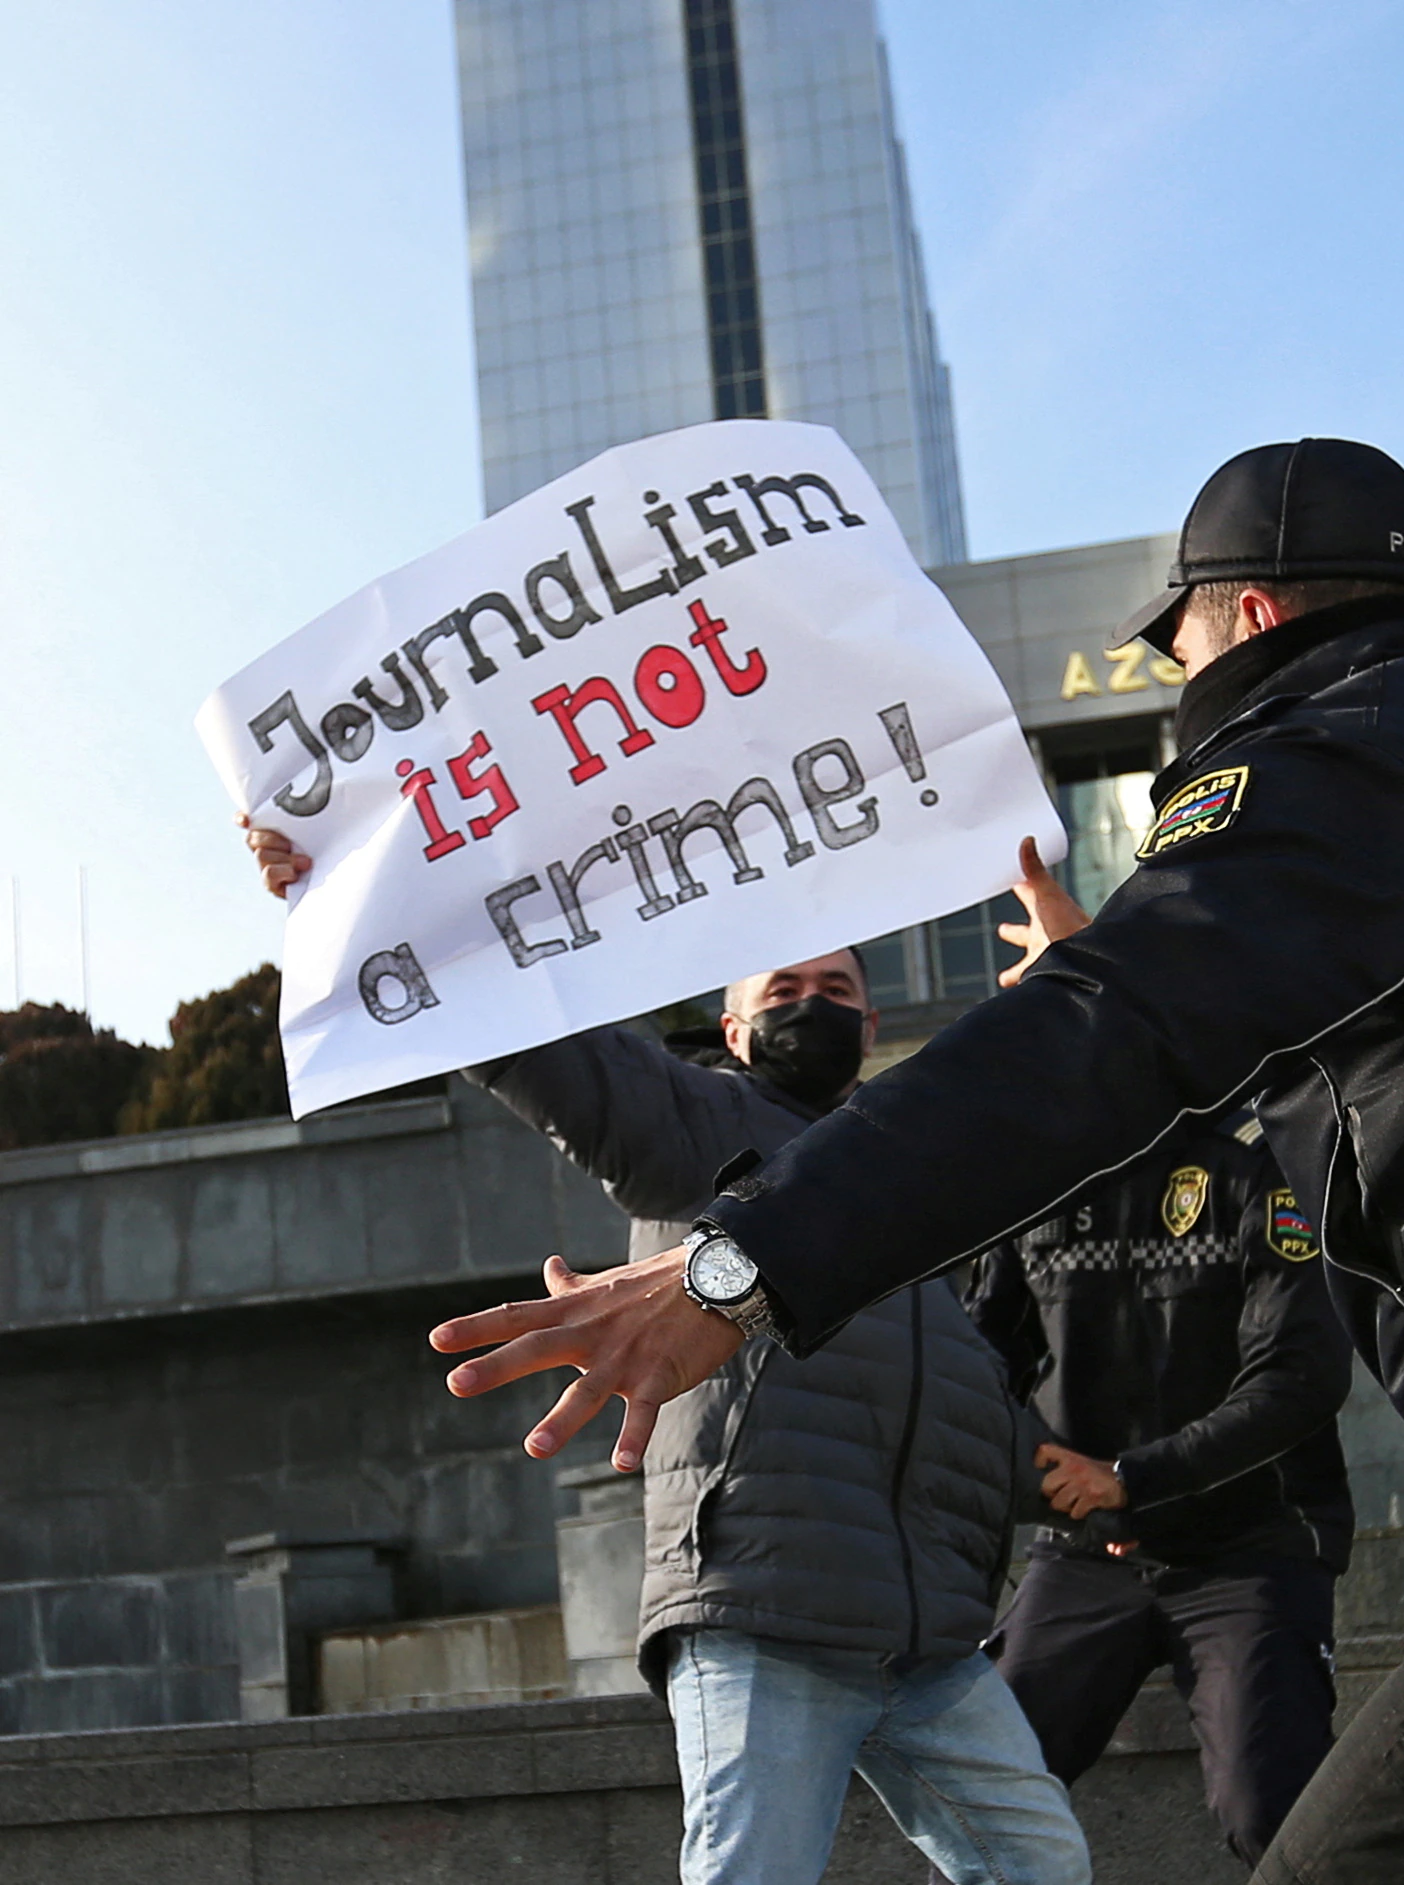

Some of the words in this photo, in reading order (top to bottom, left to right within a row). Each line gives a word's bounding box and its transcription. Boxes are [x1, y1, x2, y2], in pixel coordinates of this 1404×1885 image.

[393, 729, 521, 863] is
[531, 598, 768, 787] not
[1154, 816, 1215, 853] PPX
[357, 942, 441, 1026] a
[484, 701, 940, 969] crime!
